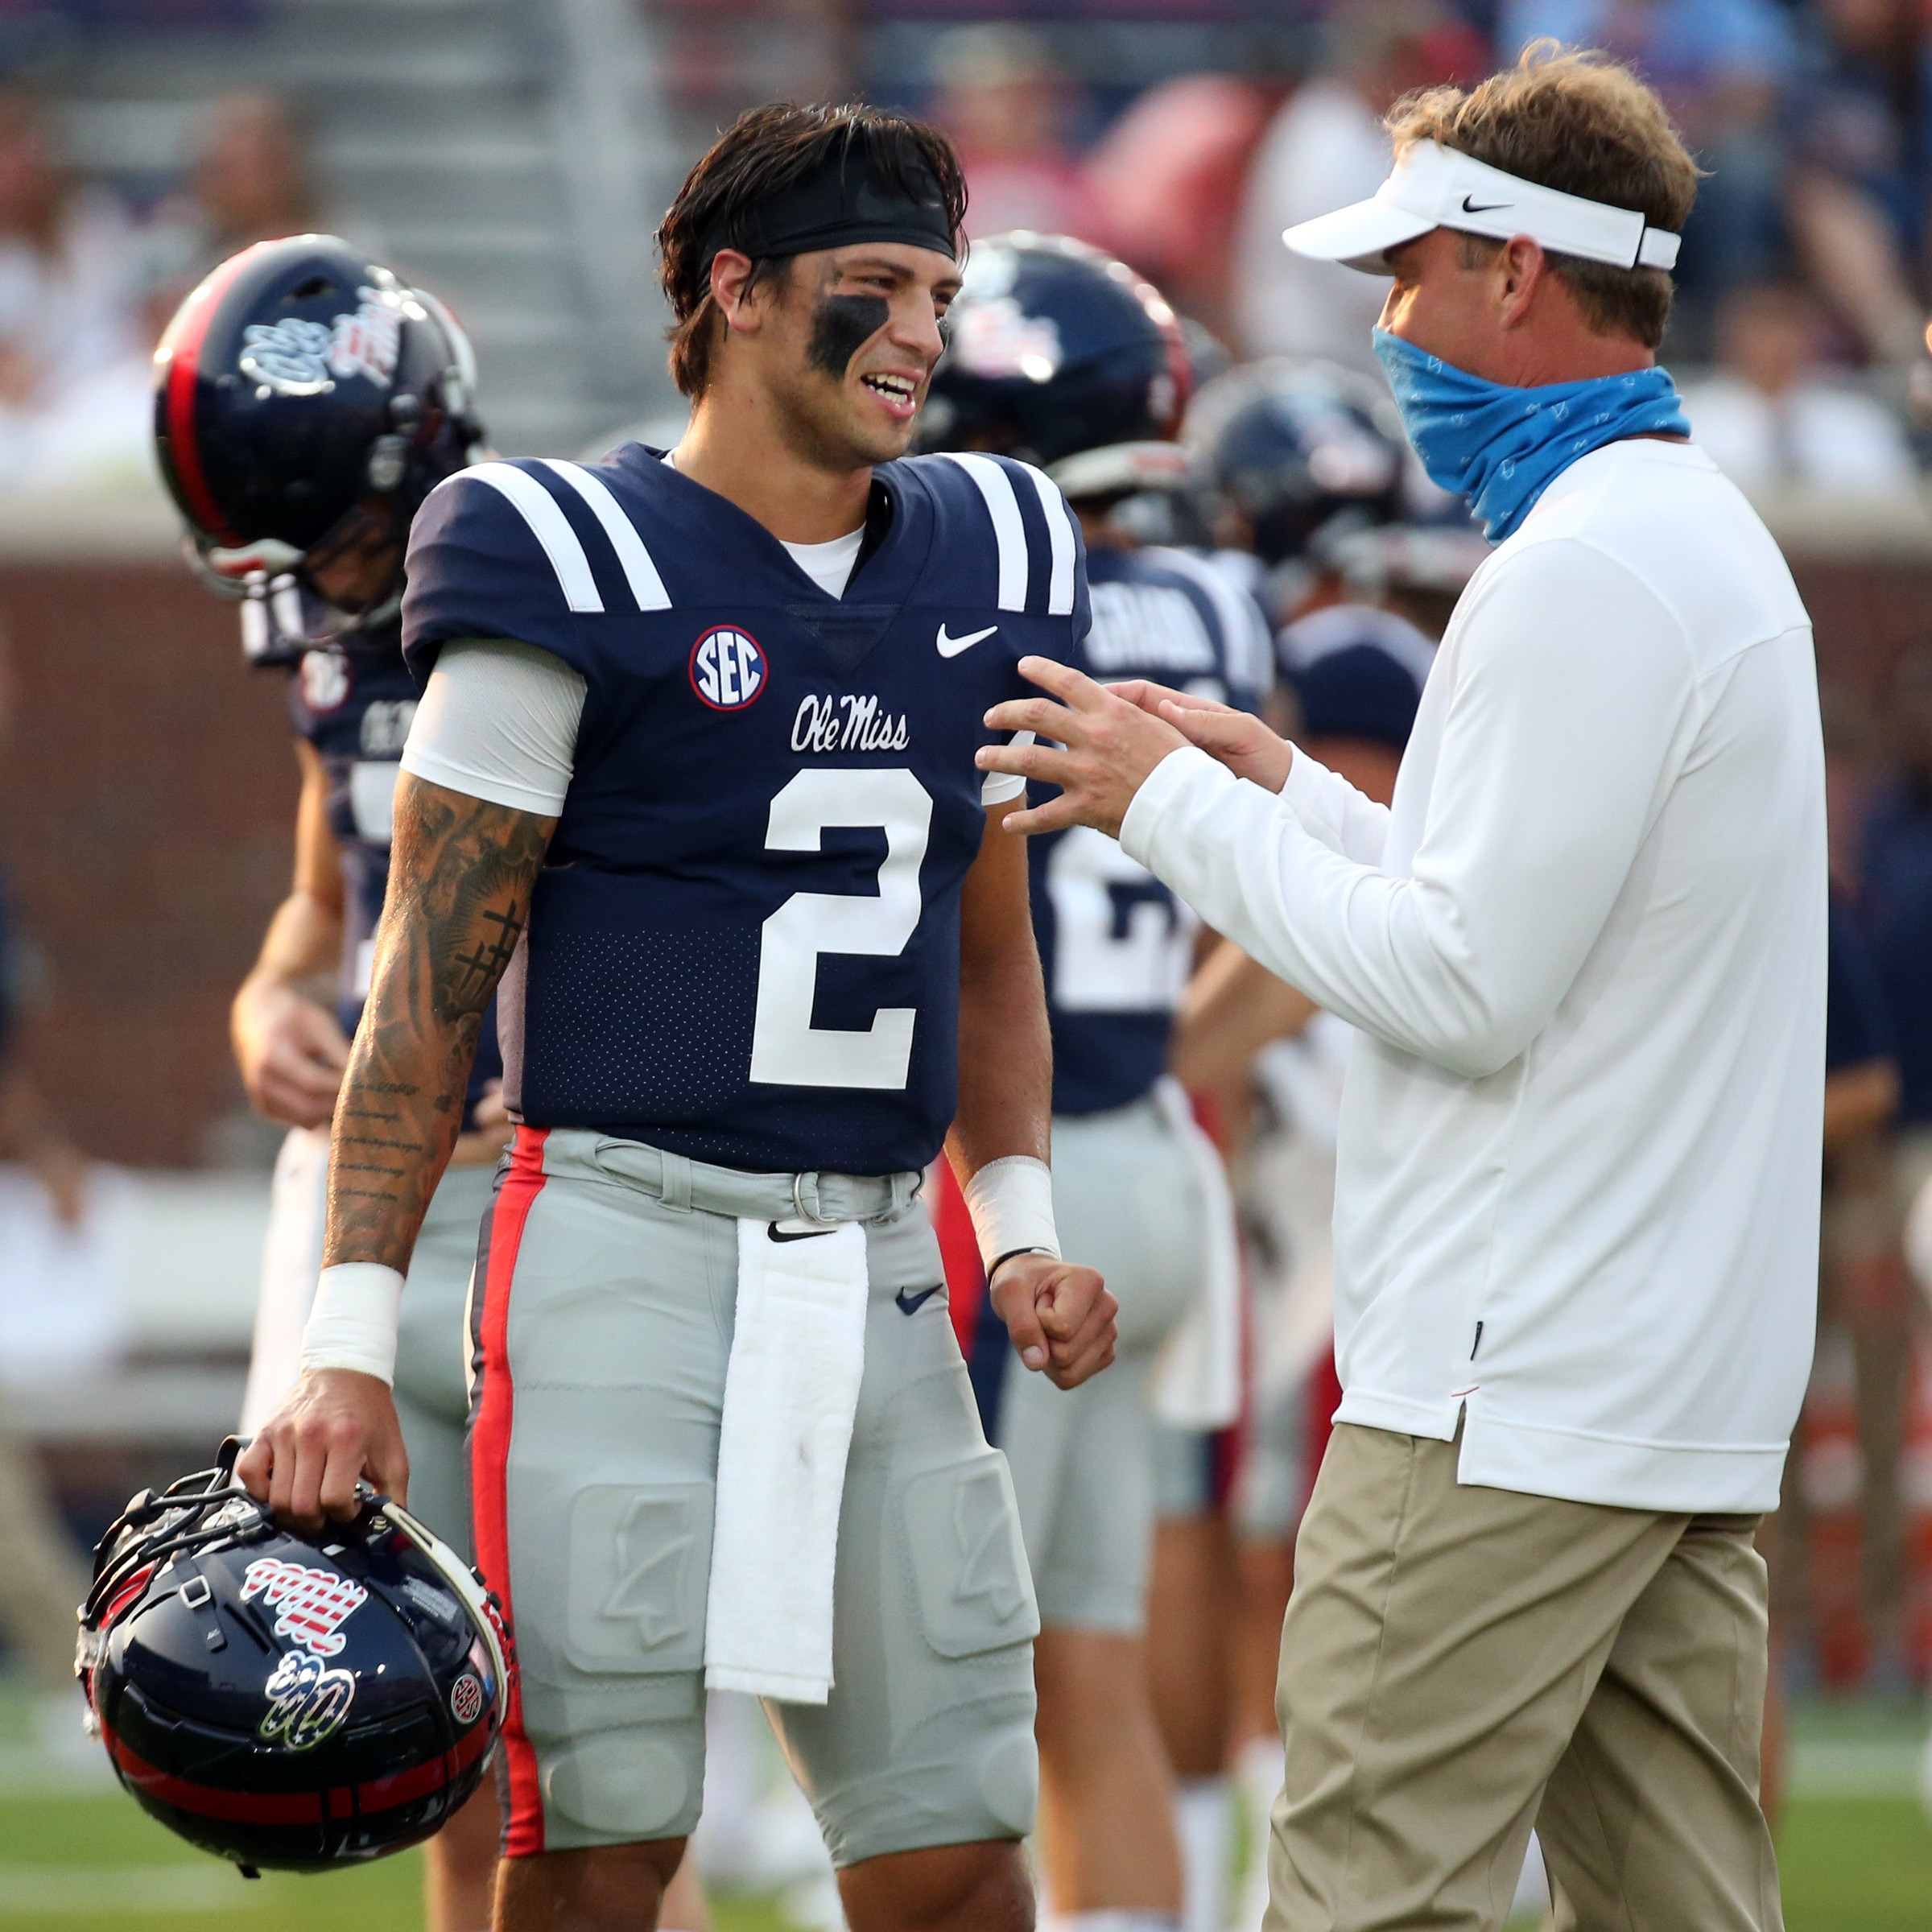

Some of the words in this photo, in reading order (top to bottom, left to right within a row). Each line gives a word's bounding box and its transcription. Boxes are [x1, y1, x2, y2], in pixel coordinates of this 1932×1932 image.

[696, 631, 761, 705] SEC
[791, 694, 837, 753] Ole
[840, 694, 910, 752] Miss
[749, 768, 934, 1090] 2
[240, 1557, 369, 1657] Miss
[259, 1649, 356, 1752] Ole
[453, 1677, 481, 1720] SEC
